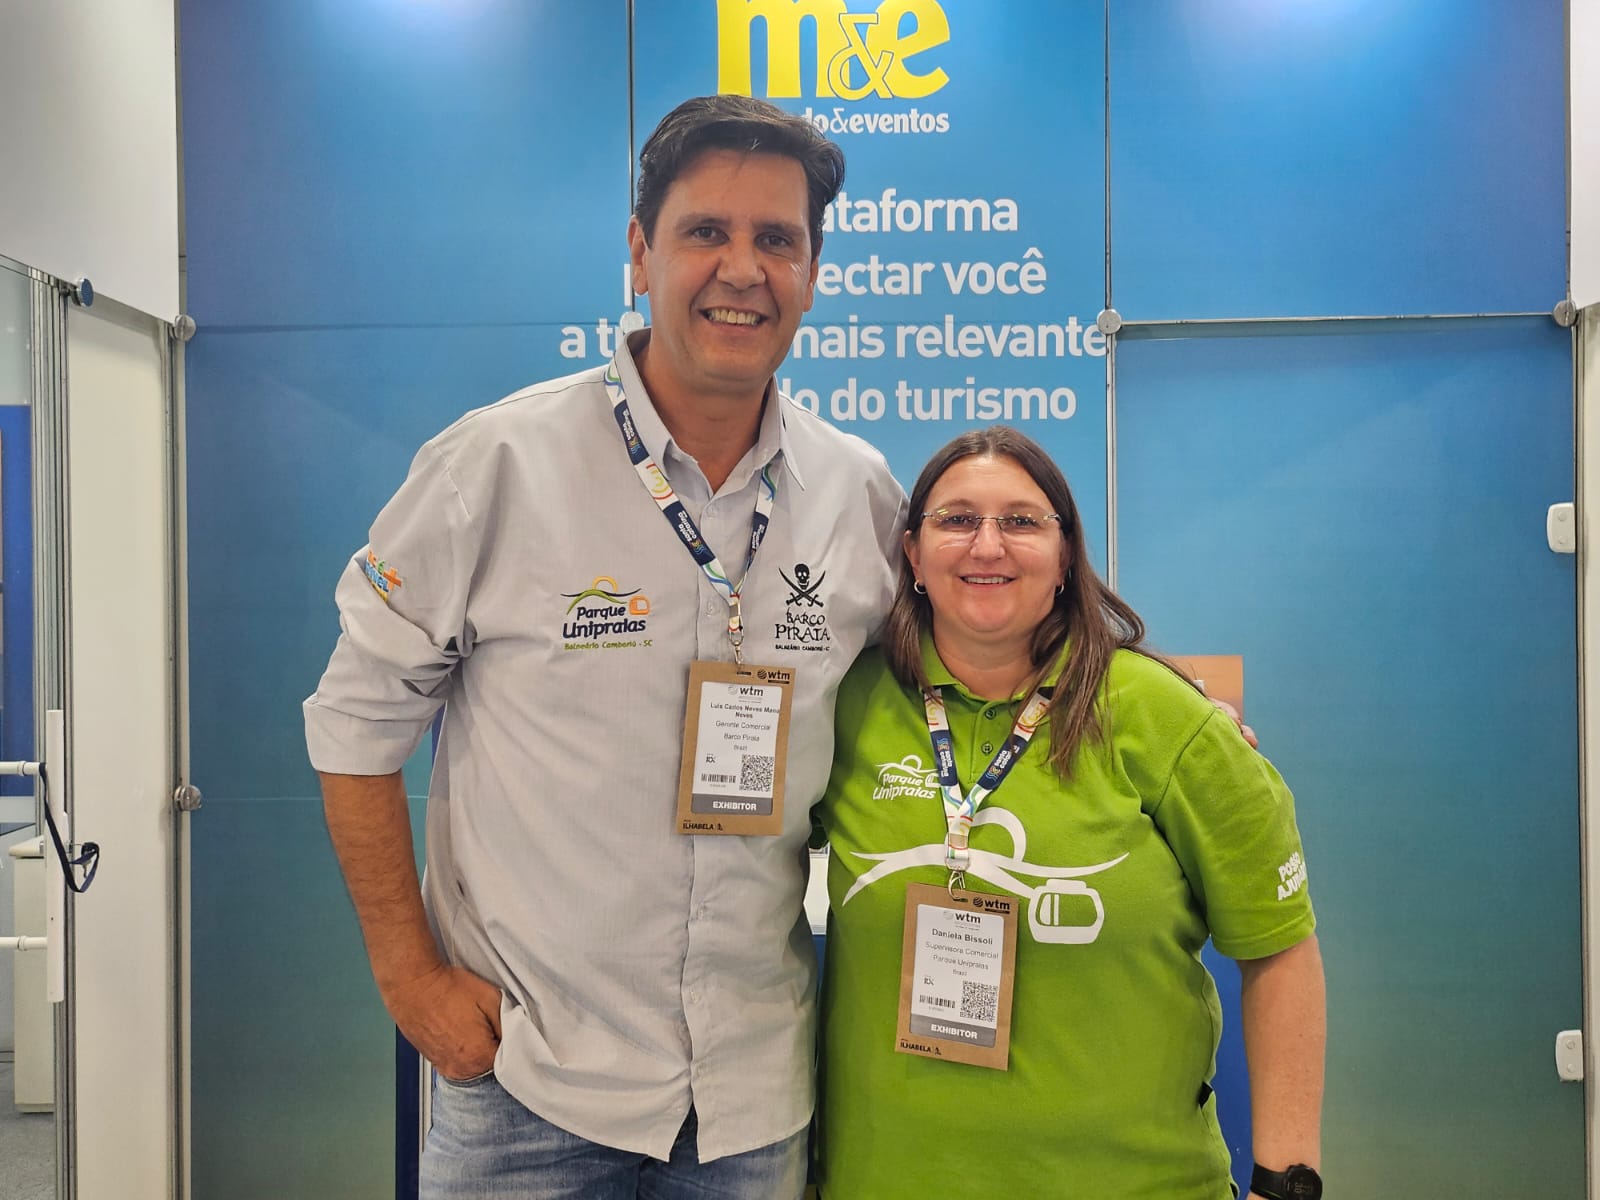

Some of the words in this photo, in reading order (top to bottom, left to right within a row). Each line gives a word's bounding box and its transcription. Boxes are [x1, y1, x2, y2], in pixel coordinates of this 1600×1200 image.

[816, 255, 935, 295] ectar
[942, 247, 1047, 295] você
[559, 324, 587, 359] a
[896, 315, 1108, 359] relevante
[830, 377, 886, 421] do
[896, 377, 1077, 421] turismo
[577, 606, 626, 621] Parque
[785, 607, 826, 627] BARCO
[562, 618, 647, 640] Unipraias
[775, 623, 831, 643] PIRATA
[643, 639, 653, 647] SC
[768, 670, 791, 681] wtm
[740, 686, 764, 697] wtm
[735, 711, 754, 719] Neves
[883, 773, 923, 786] Parque
[872, 784, 937, 801] Unipraias
[712, 801, 757, 811] EXHIBITOR
[682, 822, 714, 830] ILHABELA
[984, 898, 1010, 910] wtm
[955, 912, 981, 924] wtm
[932, 928, 962, 940] Daniela
[964, 933, 993, 945] Bissoli
[965, 948, 999, 960] Comercial
[930, 1023, 978, 1040] EXHIBITOR
[900, 1041, 932, 1053] ILHABELA
